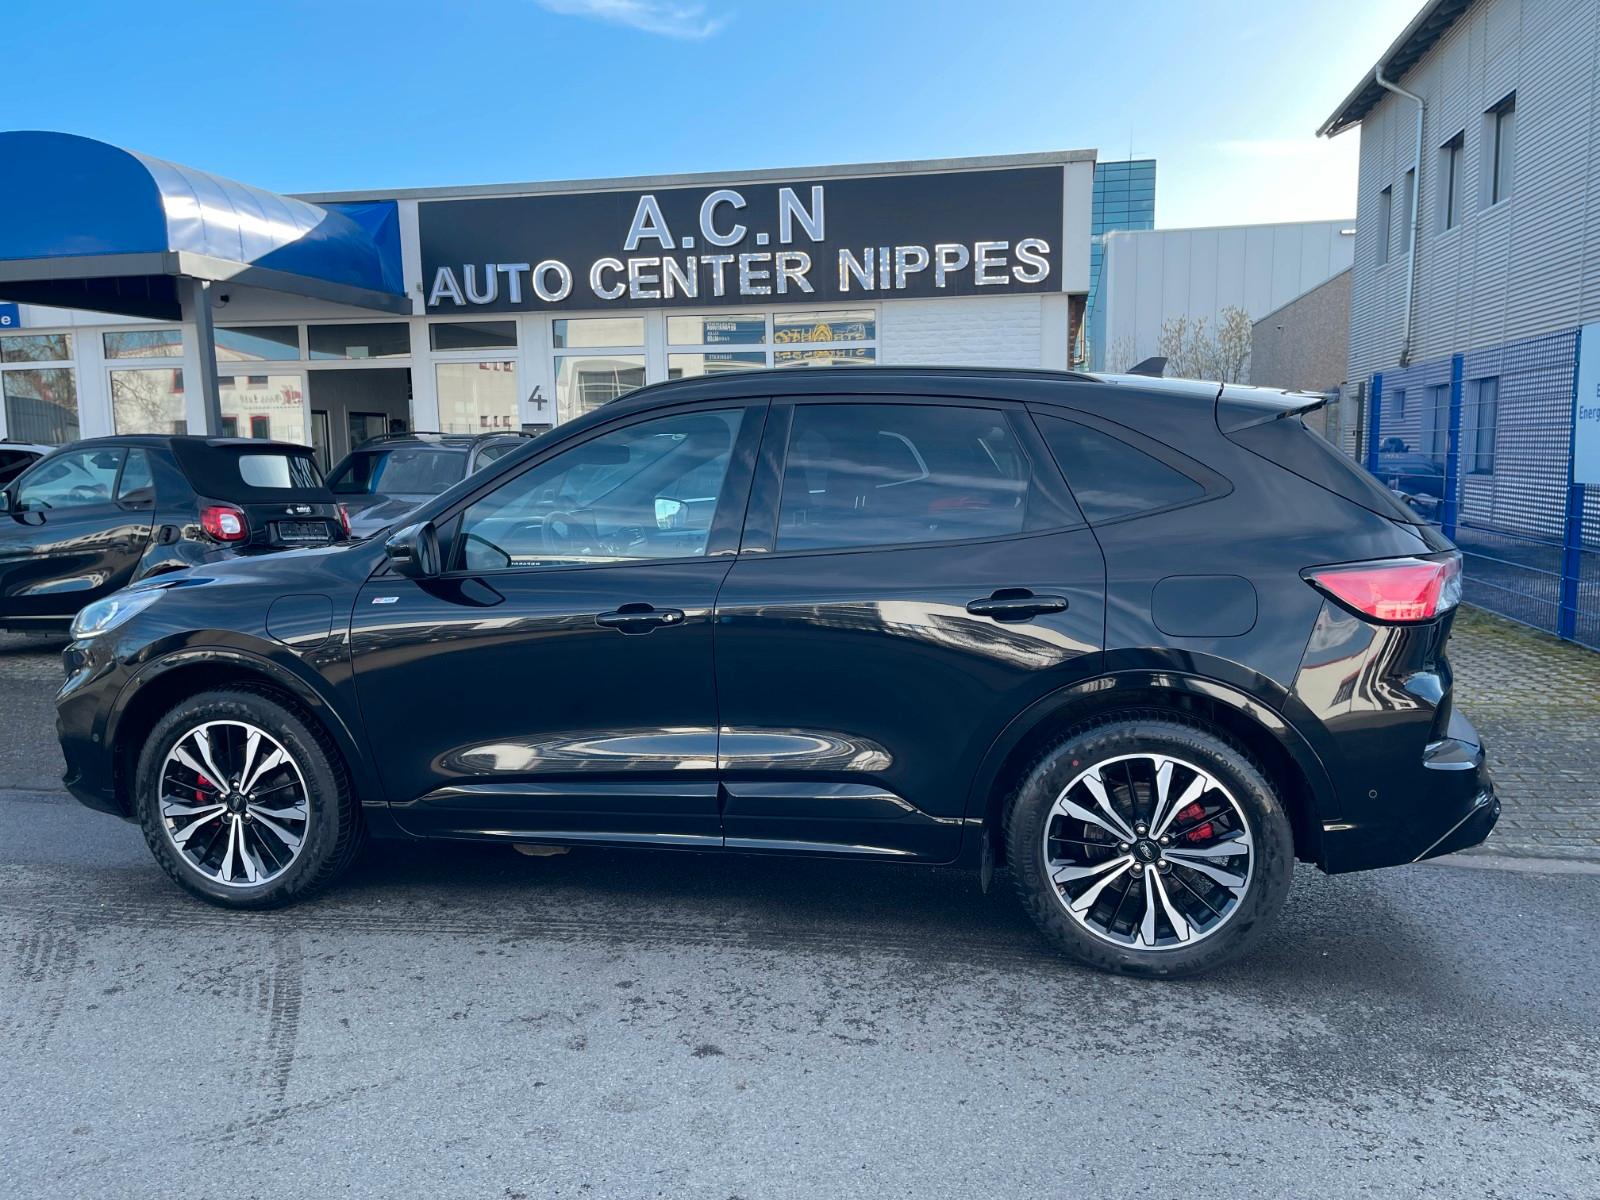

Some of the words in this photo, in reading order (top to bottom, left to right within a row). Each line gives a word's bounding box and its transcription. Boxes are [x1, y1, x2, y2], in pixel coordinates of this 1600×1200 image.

[624, 185, 825, 250] A.C.N
[427, 259, 573, 307] AUTO
[589, 251, 815, 299] CENTER
[838, 238, 1051, 292] NIPPES
[527, 384, 549, 412] 4
